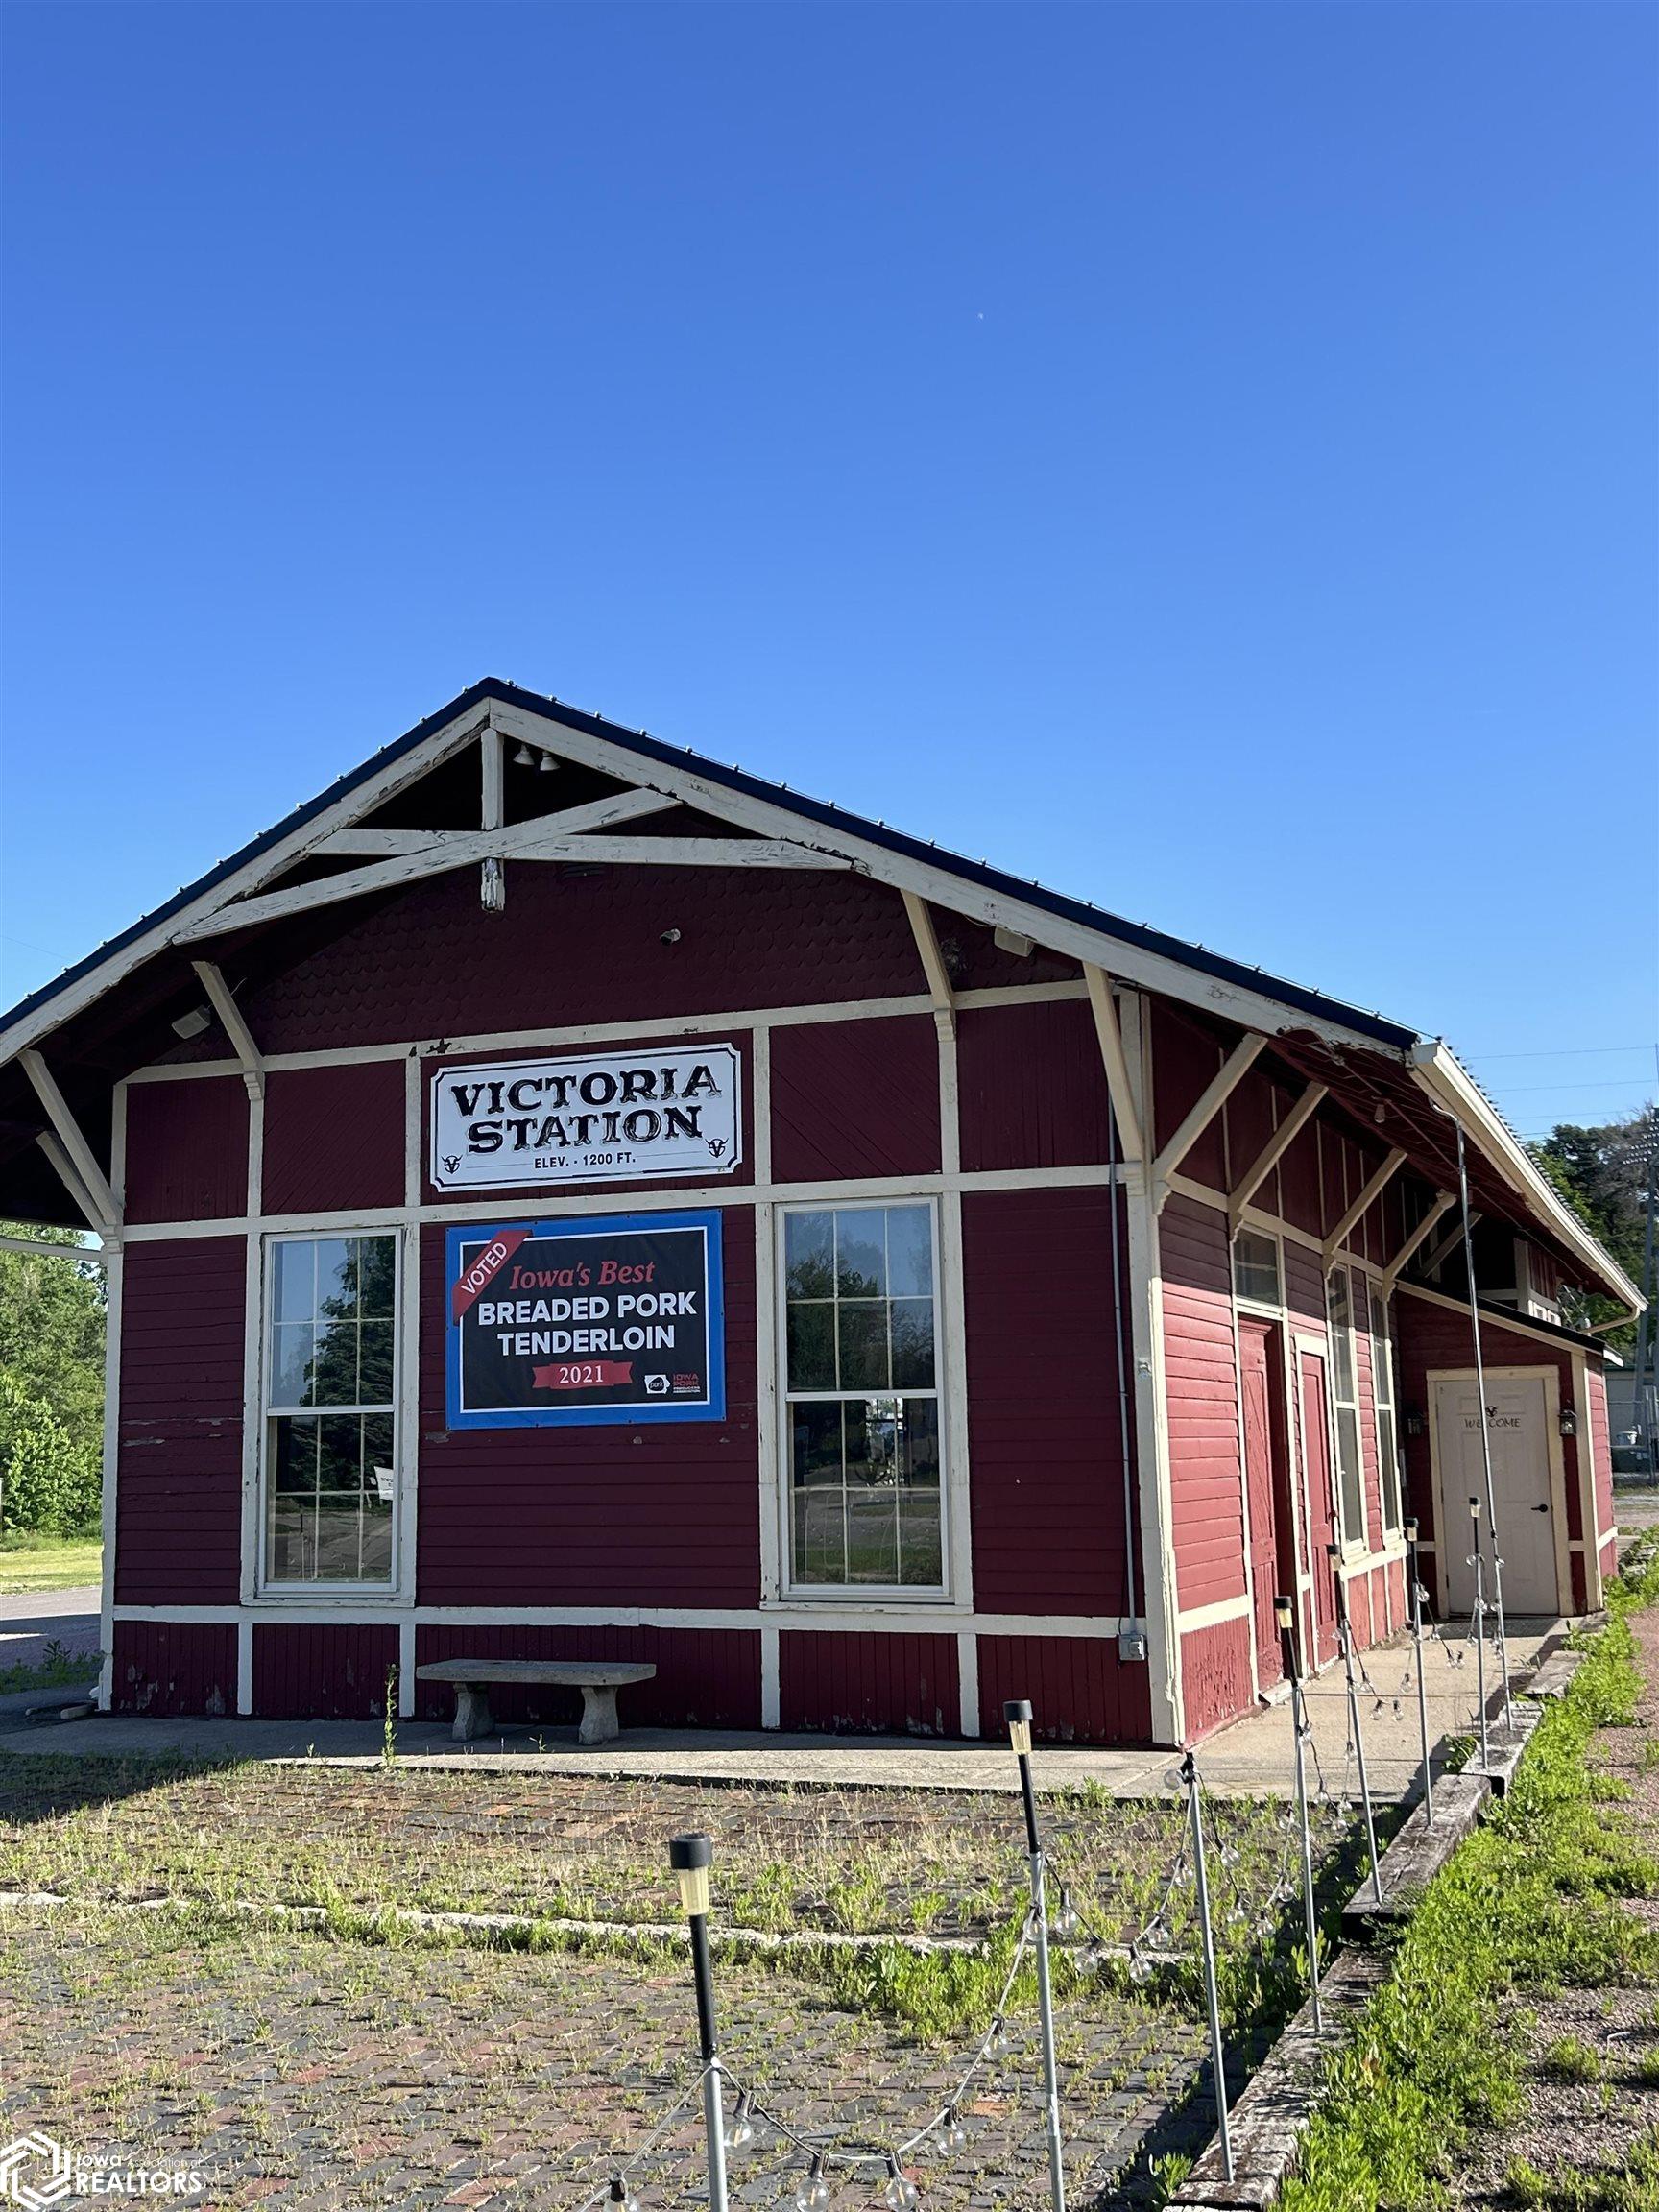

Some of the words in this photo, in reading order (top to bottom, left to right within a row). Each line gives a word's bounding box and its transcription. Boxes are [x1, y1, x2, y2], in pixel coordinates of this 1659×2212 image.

[450, 1065, 722, 1118] VICTORIA
[467, 1105, 703, 1154] STATION
[534, 1156, 568, 1169] ELEV.
[583, 1153, 613, 1166] 1200
[616, 1151, 636, 1164] FT.
[461, 1241, 508, 1295] VOTED
[509, 1262, 590, 1290] Iowa's
[598, 1260, 656, 1286] Best
[478, 1296, 610, 1326] BREADED
[617, 1290, 698, 1319] PORK
[497, 1324, 675, 1357] TENDERLOIN
[559, 1365, 604, 1385] 2021
[1464, 1417, 1521, 1428] WECOME
